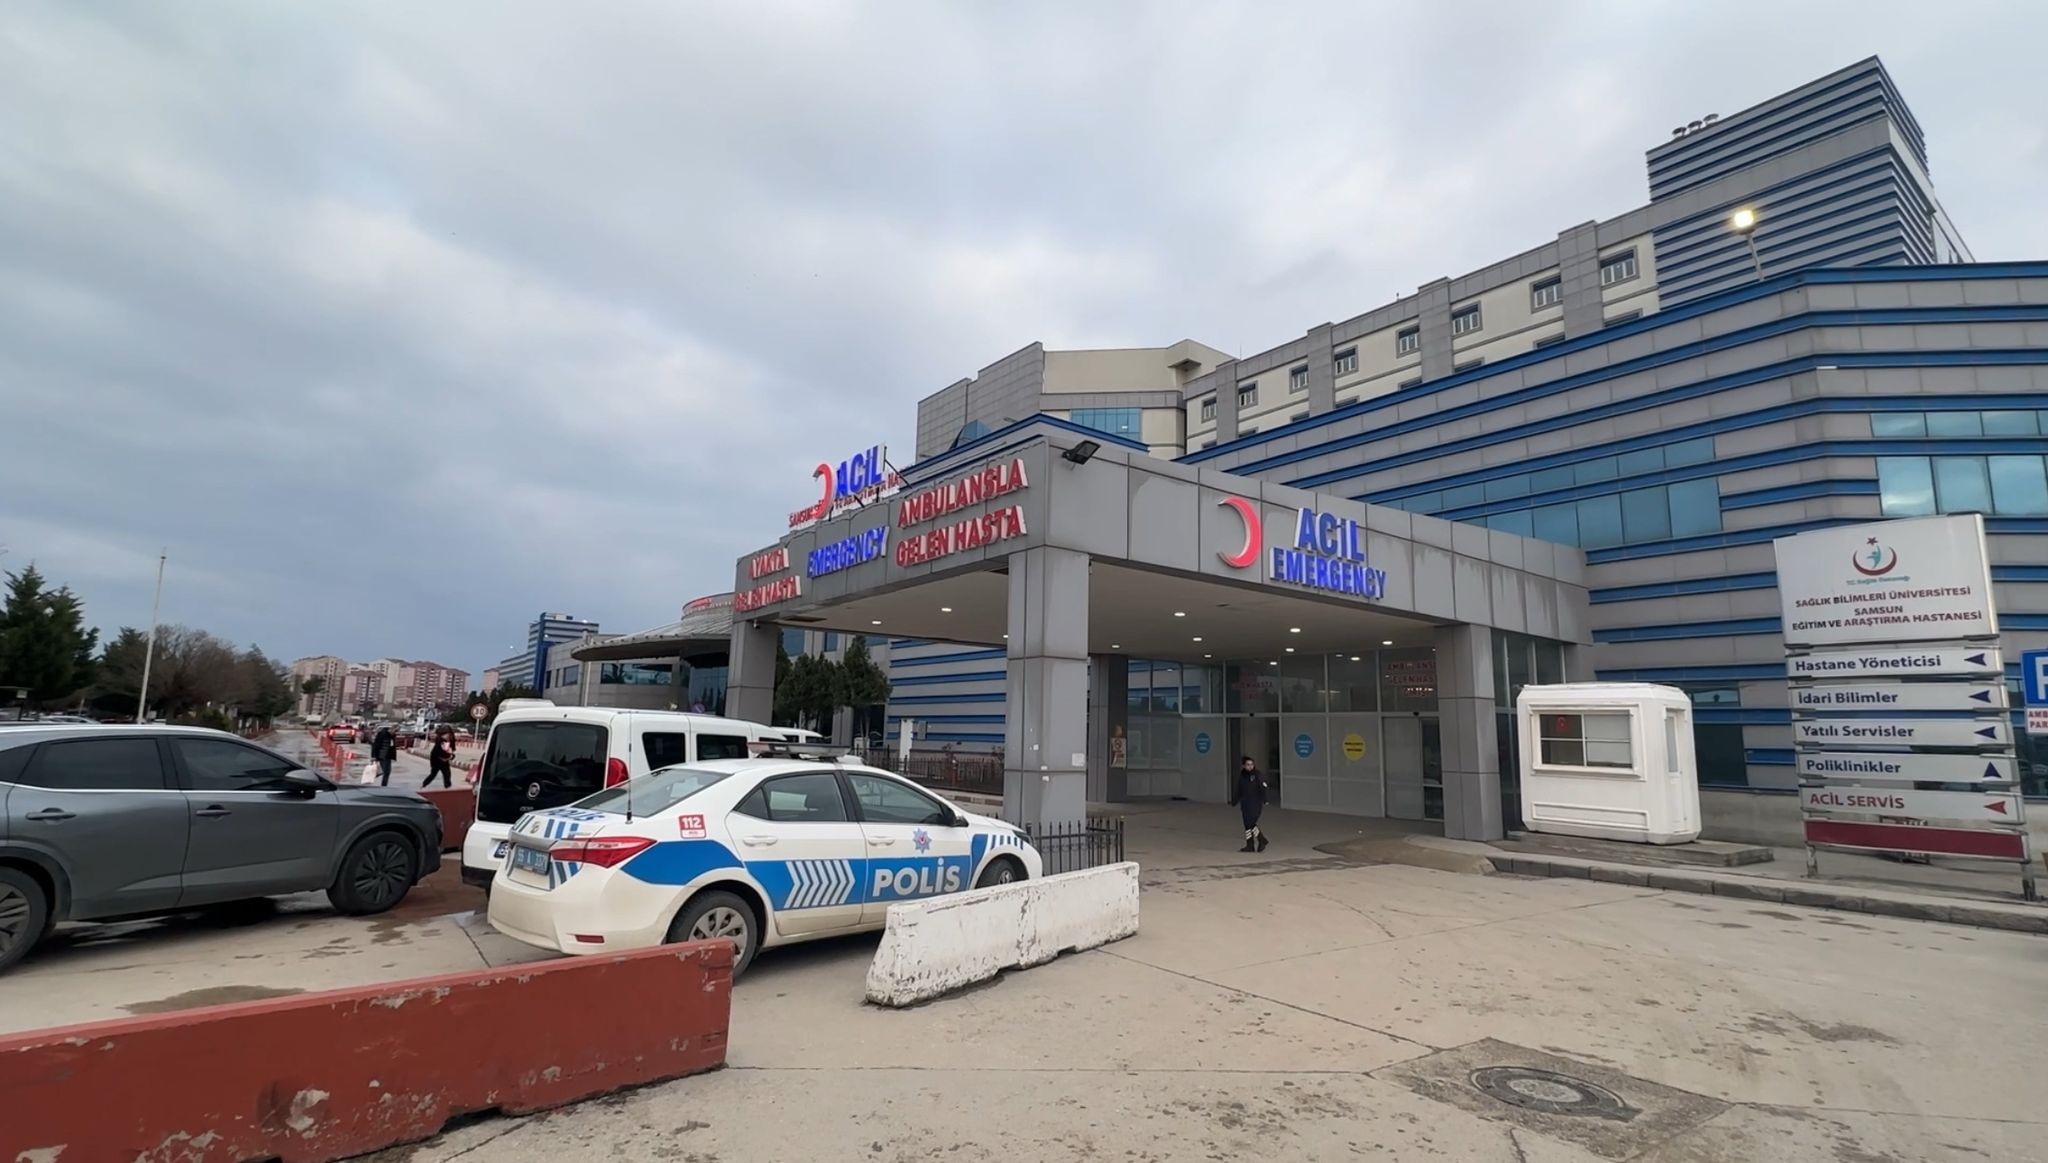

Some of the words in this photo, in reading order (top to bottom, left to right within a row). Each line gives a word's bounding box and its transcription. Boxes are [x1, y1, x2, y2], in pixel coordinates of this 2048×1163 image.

[836, 445, 885, 499] ACİL
[898, 459, 1029, 528] AMBULANSLA
[896, 525, 954, 568] GELEN
[955, 505, 1027, 550] HASTA
[1294, 507, 1365, 563] ACİL
[807, 526, 890, 579] EMERGENCY
[1269, 547, 1386, 600] EMERGENCY
[1795, 596, 1831, 608] SAĞLIK
[1833, 592, 1886, 605] BİLİMLERİ
[1889, 586, 1971, 600] ÜNİVERSİTESİ
[1829, 619, 1842, 628] VE
[1844, 615, 1910, 627] ARAŞTIRMA
[1913, 610, 1982, 622] HASTANESİ
[1854, 605, 1903, 616] SAMSUN
[1795, 659, 1856, 672] Hastane
[1859, 655, 1942, 669] Yöneticisi
[1835, 691, 1898, 704] Bilimler
[1802, 725, 1838, 737] Yatılı
[1842, 725, 1914, 738] Servisler
[1806, 760, 1901, 774] Poliklinikler
[1810, 792, 1844, 806] ACİL
[1847, 794, 1905, 810] SERVİS
[681, 816, 702, 829] 112
[872, 858, 960, 897] POLİS
